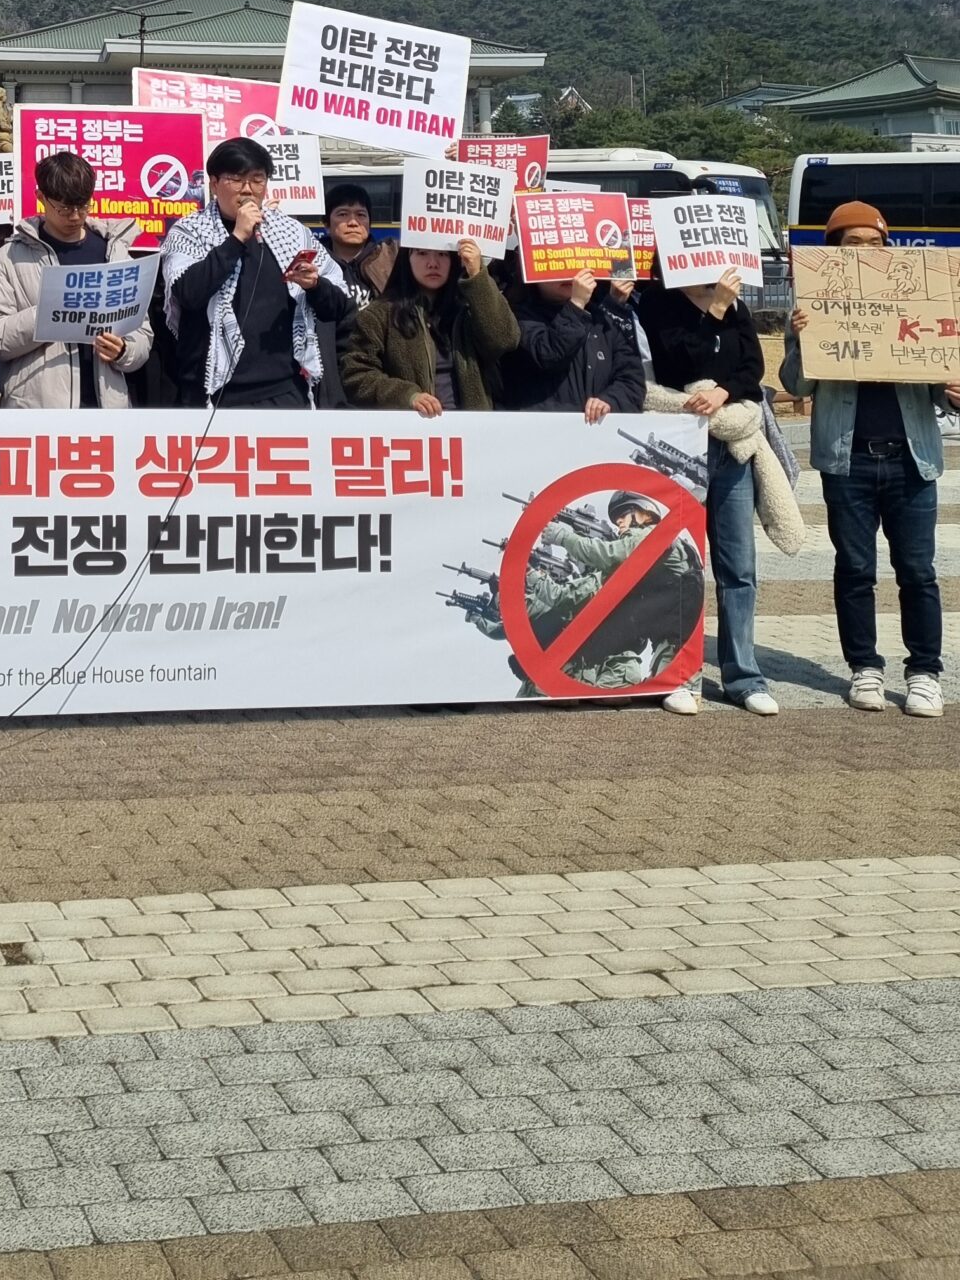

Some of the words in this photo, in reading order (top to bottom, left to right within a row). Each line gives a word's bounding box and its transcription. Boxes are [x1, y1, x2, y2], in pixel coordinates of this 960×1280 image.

[321, 24, 377, 59] 이란
[384, 37, 441, 72] 전쟁
[150, 78, 186, 97] 한국
[190, 83, 242, 104] 정부는
[319, 56, 435, 105] 반대한다
[291, 85, 318, 110] NO
[324, 92, 370, 121] WAR
[376, 107, 402, 128] on
[407, 109, 455, 138] IRAN
[35, 118, 77, 141] 한국
[82, 119, 144, 143] 정부는
[82, 145, 123, 167] 전쟁
[272, 188, 287, 199] on
[290, 186, 316, 199] IRAN
[425, 169, 465, 191] 이란
[469, 173, 501, 197] 전쟁
[97, 198, 150, 215] Korean
[152, 198, 198, 216] Troops
[426, 193, 497, 220] 반대한다
[525, 199, 554, 214] 한국
[556, 198, 594, 212] 정부는
[673, 204, 714, 225] 이란
[716, 204, 746, 224] 전쟁
[408, 216, 427, 232] NO
[431, 217, 464, 234] WAR
[484, 223, 505, 242] IRAN
[528, 215, 556, 229] 이란
[558, 213, 585, 228] 전쟁
[530, 231, 559, 246] 파병
[680, 226, 748, 248] 반대한다
[667, 254, 688, 270] NO
[690, 251, 726, 268] WAR
[729, 252, 741, 265] on
[742, 252, 759, 269] IRAN
[65, 271, 103, 289] 이란
[107, 265, 140, 287] 공격
[63, 292, 102, 309] 당장
[105, 285, 138, 308] 중단
[52, 310, 86, 324] STOP
[89, 303, 140, 324] Bombing
[819, 340, 874, 361] 역사를
[135, 435, 312, 497] 생각도
[331, 437, 464, 498] 말라!
[10, 514, 127, 577] 전쟁
[148, 512, 393, 575] 반대한다!
[52, 598, 96, 634] No
[164, 601, 207, 631] on
[209, 595, 287, 631] Iran!
[18, 667, 45, 686] the
[50, 666, 86, 685] Blue
[92, 666, 144, 684] House
[150, 664, 217, 683] fountain
